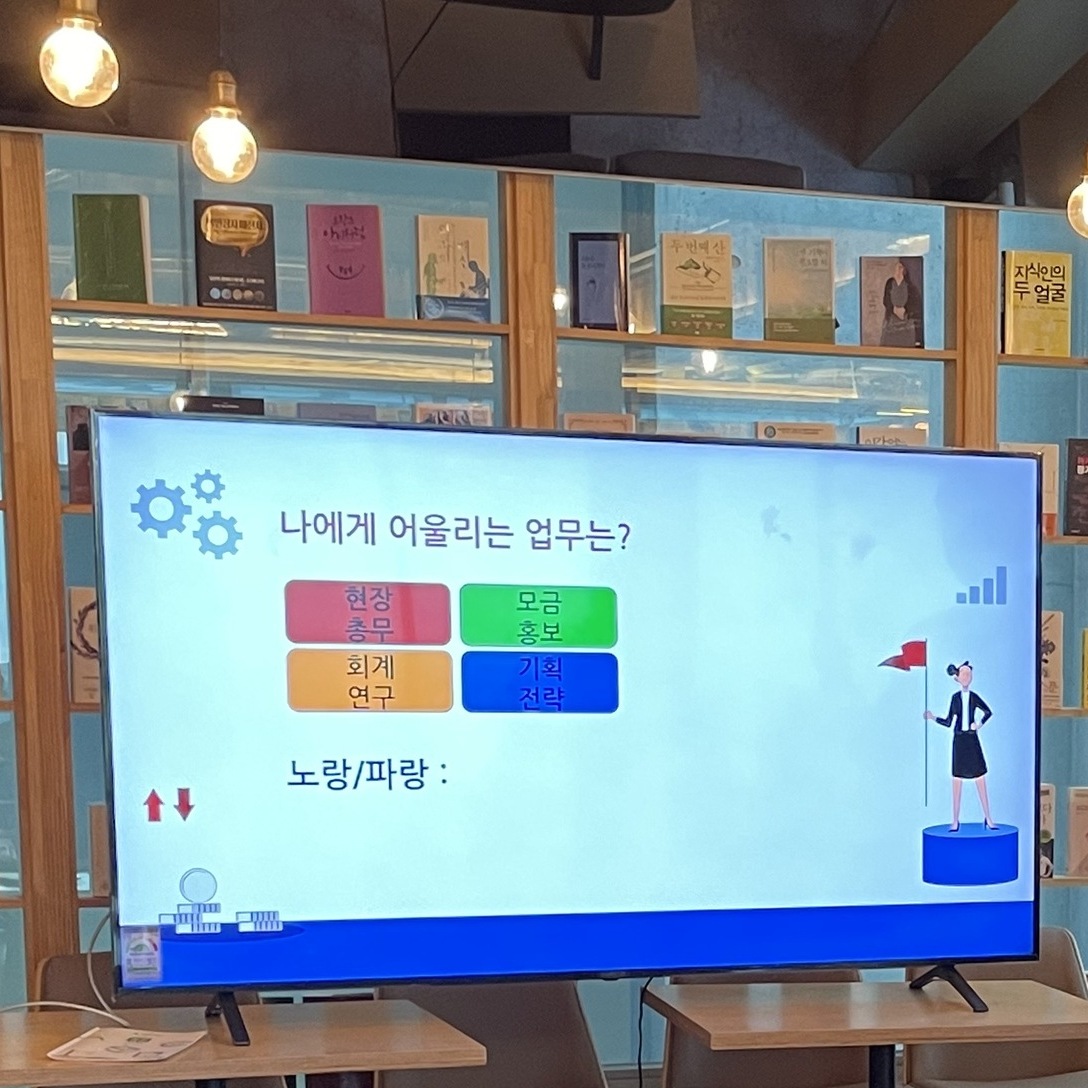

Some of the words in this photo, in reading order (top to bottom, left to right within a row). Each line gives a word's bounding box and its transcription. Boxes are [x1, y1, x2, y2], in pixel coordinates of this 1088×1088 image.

[1014, 262, 1065, 282] 지식인의
[1013, 281, 1030, 301] 두
[1034, 283, 1066, 304] 얼굴
[280, 509, 377, 546] 나에게
[389, 512, 515, 550] 어울리는
[525, 516, 631, 552] 업무는?
[344, 585, 393, 613] 현장
[515, 590, 563, 615] 모금
[344, 616, 395, 644] 총무
[516, 619, 563, 646] 홍보
[346, 653, 395, 680] 회계
[518, 656, 563, 681] 기획
[348, 684, 396, 710] 연구
[518, 686, 566, 712] 전략
[287, 757, 429, 791] 노랑/파랑
